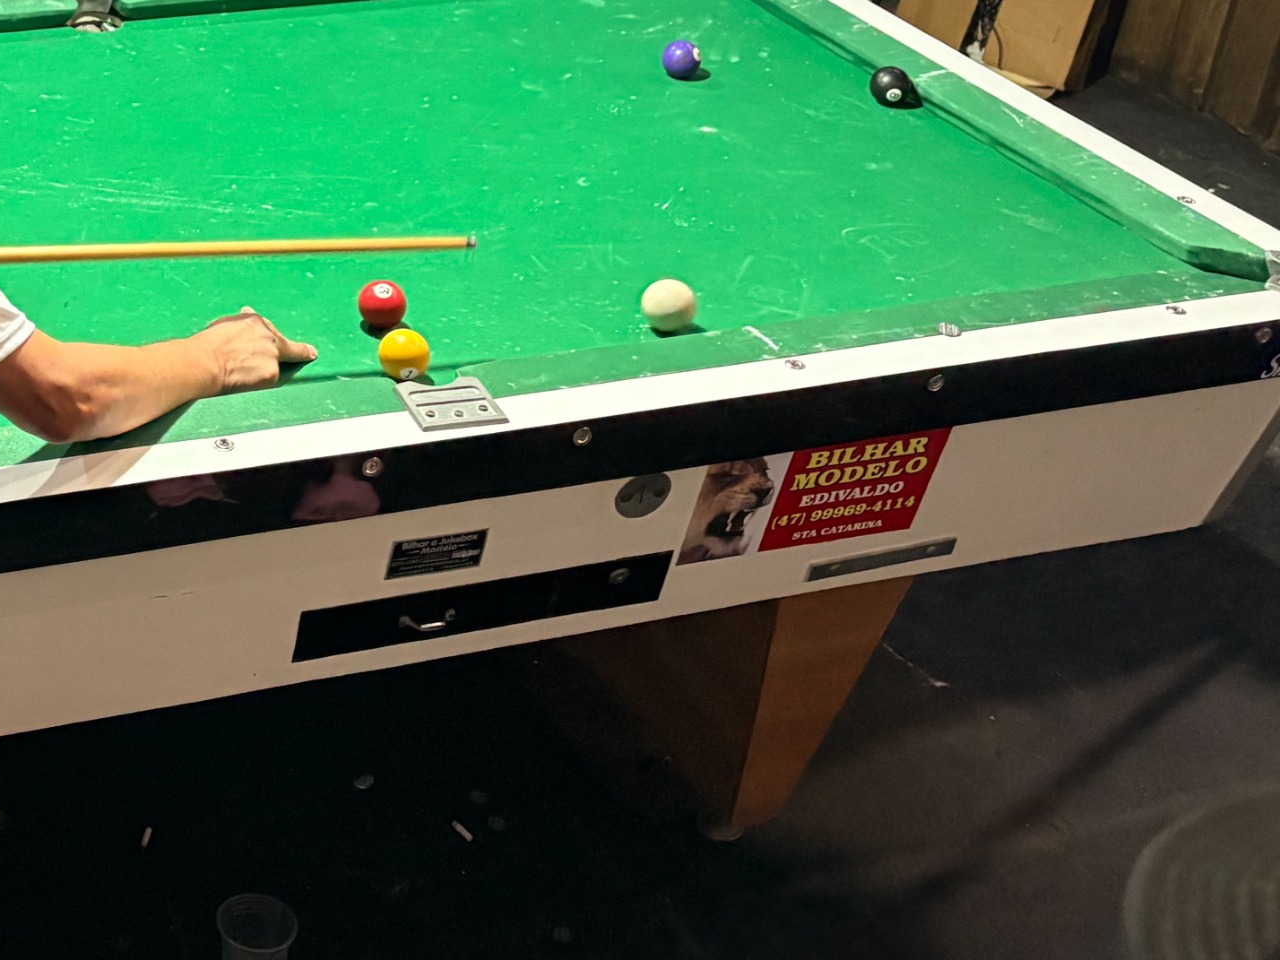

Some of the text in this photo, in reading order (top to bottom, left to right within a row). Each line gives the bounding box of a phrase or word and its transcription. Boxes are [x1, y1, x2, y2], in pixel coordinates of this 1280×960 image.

[406, 370, 414, 379] 1
[806, 437, 929, 470] BILHAR
[790, 456, 928, 491] MODELO
[799, 481, 904, 508] EDIVALDO
[771, 495, 916, 531] (47) 99969-4114
[792, 519, 883, 540] STA CATARINA
